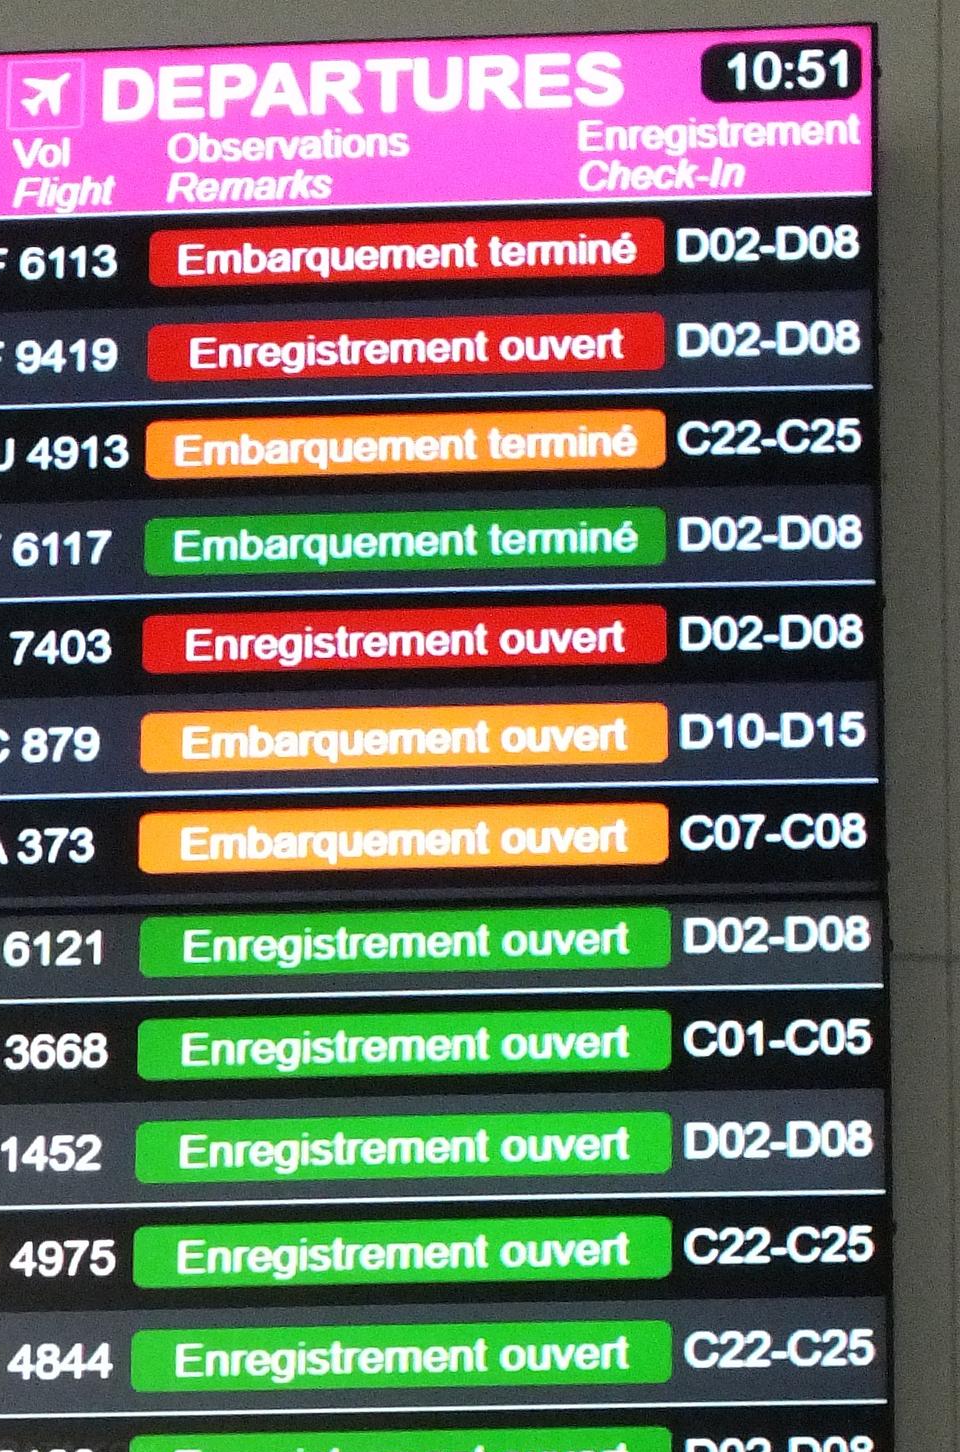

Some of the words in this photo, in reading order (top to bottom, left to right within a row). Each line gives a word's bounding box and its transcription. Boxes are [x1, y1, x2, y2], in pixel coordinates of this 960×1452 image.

[102, 52, 625, 122] DEPARTURES
[728, 50, 851, 90] 10:51
[13, 137, 70, 168] Vol
[168, 129, 410, 163] Observations
[579, 115, 860, 152] Enregistrement
[14, 175, 116, 213] Flight
[167, 170, 332, 202] Remarks
[580, 159, 746, 193] Check-In
[19, 244, 118, 280] 6113
[189, 330, 489, 374] Enregistrement
[499, 327, 624, 361] ouvert
[677, 319, 861, 358] D02-D08
[26, 434, 130, 470] 4913
[174, 524, 477, 565] Embarquement
[490, 520, 638, 554] terminé
[679, 514, 863, 552] D02-D08
[9, 628, 112, 666] 7403
[182, 720, 490, 764] Embarquement
[500, 718, 628, 753] ouvert
[680, 711, 866, 750] D10-D15
[17, 826, 95, 865] 373
[684, 914, 872, 954] D02-D08
[3, 1032, 109, 1071] 3668
[181, 1027, 489, 1072] Enregistrement
[502, 1025, 629, 1060] ouvert
[684, 1119, 873, 1160] D02-D08
[9, 1239, 116, 1278] 4975
[175, 1338, 487, 1384] Enregistrement
[501, 1336, 629, 1371] ouvert
[684, 1328, 873, 1369] C22-C25
